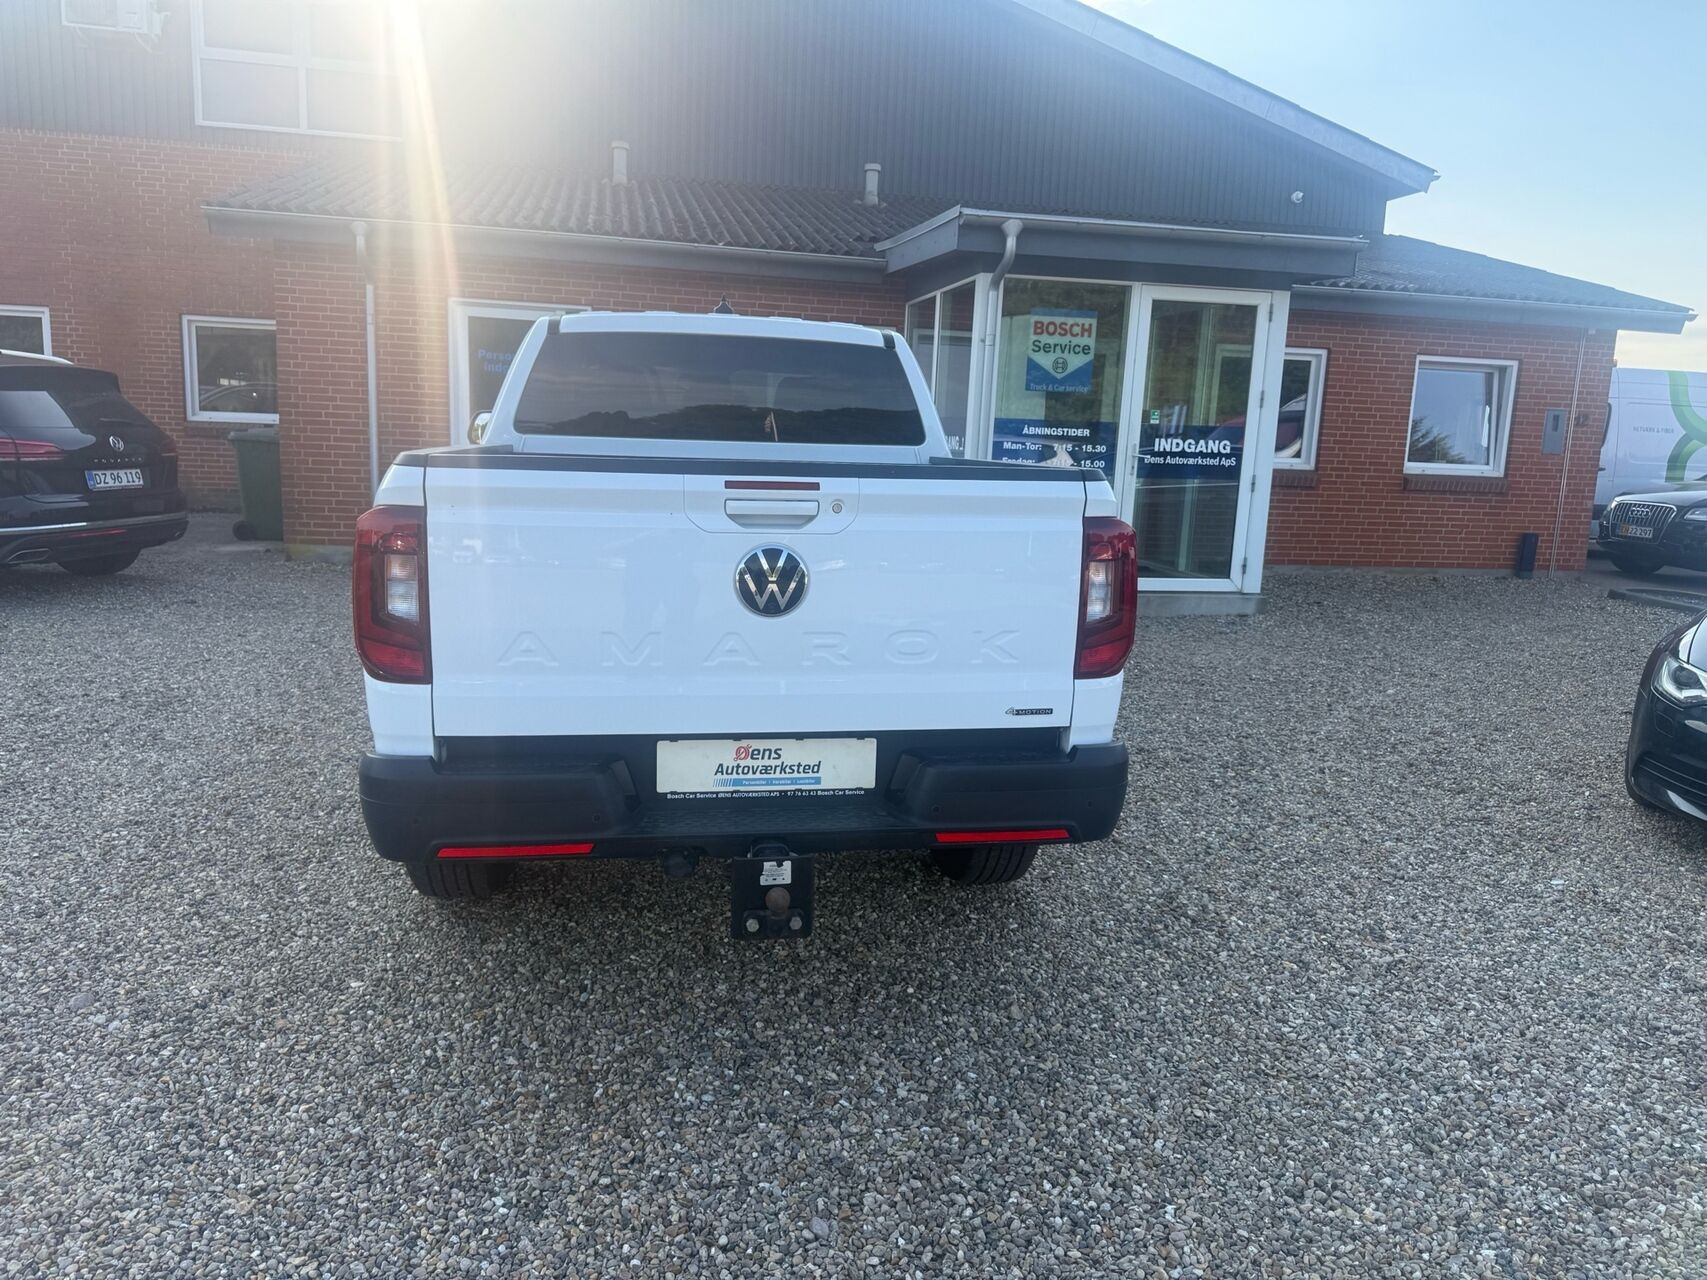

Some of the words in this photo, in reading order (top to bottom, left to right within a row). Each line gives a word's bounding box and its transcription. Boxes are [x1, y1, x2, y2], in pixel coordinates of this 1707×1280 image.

[1033, 320, 1092, 338] BOSCH
[1031, 340, 1091, 355] Service
[1022, 425, 1090, 436] ÅBNINGSTIDER
[1003, 442, 1042, 450] Man-Tor:
[1082, 445, 1106, 453] 15.30
[1154, 438, 1231, 454] INDGANG
[1080, 460, 1105, 468] 15.00
[1165, 456, 1219, 466] Autoværksted
[1220, 457, 1236, 467] ApS
[94, 472, 109, 485] DZ
[110, 472, 123, 485] 96
[124, 471, 141, 484] 119
[496, 629, 1021, 667] AMAROK
[1005, 706, 1053, 716] 4MOTION
[733, 743, 782, 762] Øens
[714, 760, 822, 776] Autoværksted
